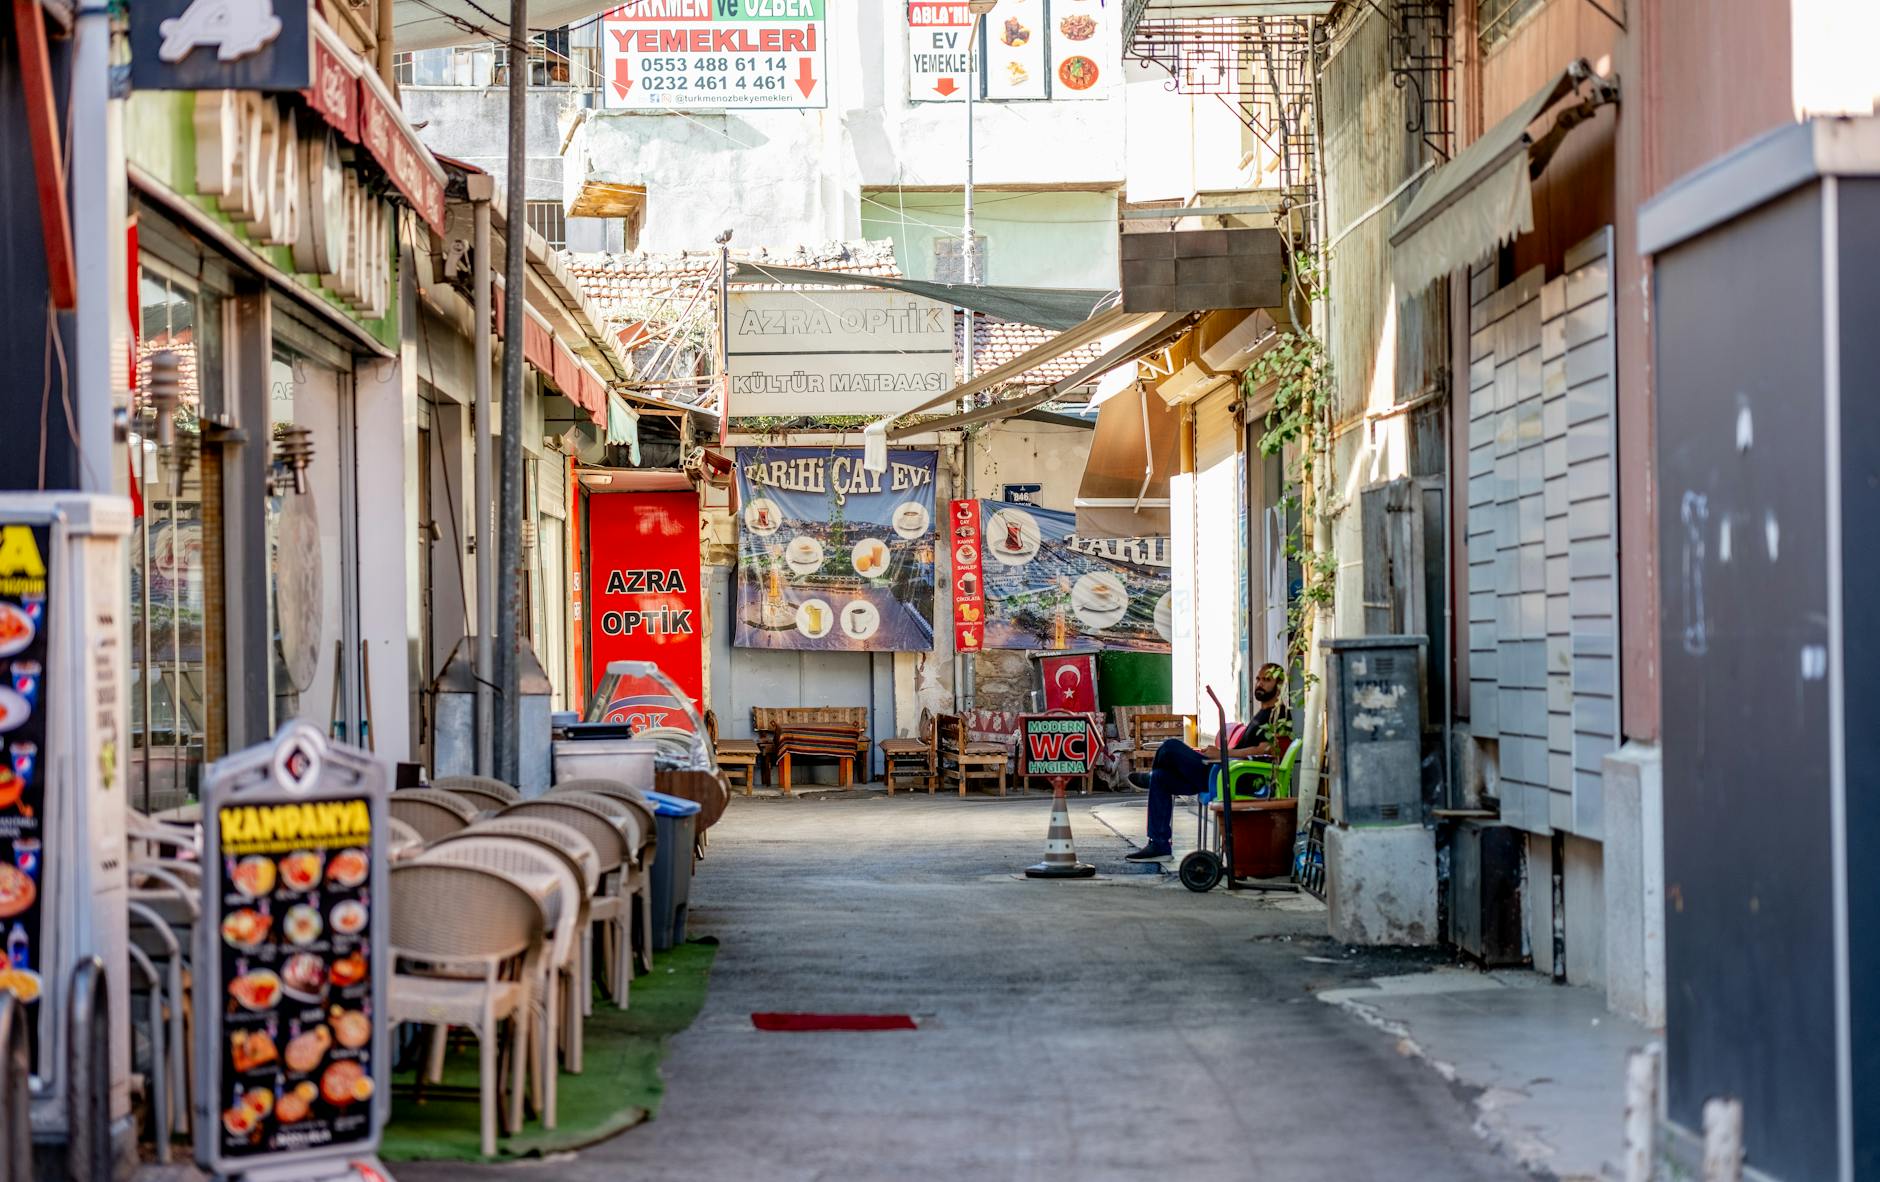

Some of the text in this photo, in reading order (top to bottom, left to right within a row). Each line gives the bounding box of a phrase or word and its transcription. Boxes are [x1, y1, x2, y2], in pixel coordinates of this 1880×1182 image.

[610, 23, 817, 52] YEMEKLERİ
[932, 32, 958, 49] EV
[641, 57, 787, 72] 0553 488 61 14
[642, 76, 785, 91] 0232 461 4 461
[675, 94, 793, 104] @turkmenozbekyemekleri
[739, 302, 944, 335] AZRA OPTİK
[733, 371, 947, 394] KÜLTÜR MATBAASI
[605, 569, 687, 594] AZRA
[601, 604, 694, 636] OPTİK
[1027, 720, 1085, 733] MODERN
[1028, 733, 1085, 761] WC
[1028, 761, 1085, 774] HYGIENA
